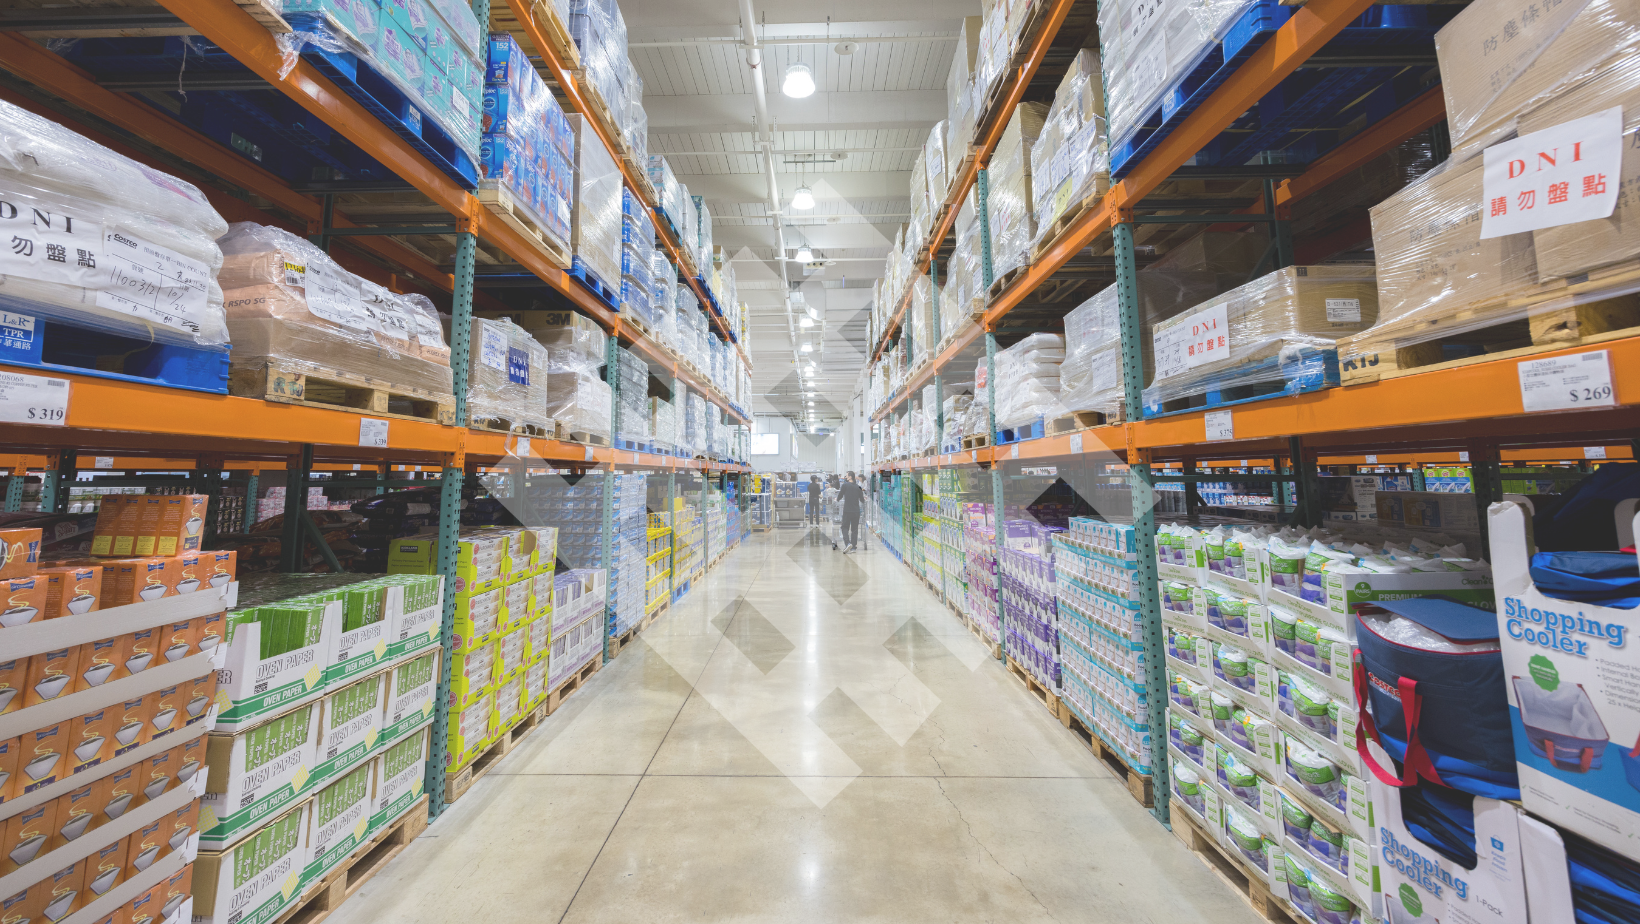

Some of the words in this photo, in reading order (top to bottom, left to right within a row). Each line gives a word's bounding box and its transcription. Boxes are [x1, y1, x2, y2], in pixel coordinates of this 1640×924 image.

[1507, 141, 1584, 180] DNI
[1490, 173, 1607, 218] 請勿盤點
[113, 233, 138, 248] COSTCO
[228, 299, 251, 308] RSPO
[253, 297, 266, 305] SG
[546, 313, 571, 326] 3M
[1192, 318, 1217, 337] DNI
[3, 327, 25, 339] TPR
[1569, 389, 1579, 403] $
[1582, 385, 1612, 401] 269
[28, 407, 36, 419] $
[39, 408, 64, 421] 319
[1504, 597, 1625, 647] Shopping
[340, 632, 359, 650] OVEN
[359, 625, 381, 643] PAPER
[416, 635, 428, 646] PAPER
[1506, 618, 1588, 656] Cooler
[256, 658, 284, 680] OVEN
[284, 649, 314, 671] PAPER
[345, 661, 359, 674] OVEN
[359, 655, 374, 668] PAPER
[1601, 674, 1623, 684] Smart
[263, 693, 282, 707] OVEN
[282, 685, 303, 700] PAPER
[328, 725, 349, 746] OVEN
[349, 713, 373, 735] PAPER
[409, 714, 422, 727] PAPER
[333, 756, 347, 770] OVEN
[348, 746, 364, 762] PAPER
[241, 767, 270, 793] OVEN
[271, 750, 301, 778] PAPER
[250, 801, 268, 819] OVEN
[268, 789, 290, 808] PAPER
[321, 853, 336, 868] OVEN
[336, 839, 353, 857] PAPER
[1380, 826, 1468, 899] Shopping
[1382, 845, 1442, 897] Cooler
[229, 879, 259, 912] OVEN
[260, 857, 291, 891] PAPER
[258, 898, 280, 919] PAPER
[1475, 894, 1504, 918] 1-Pack
